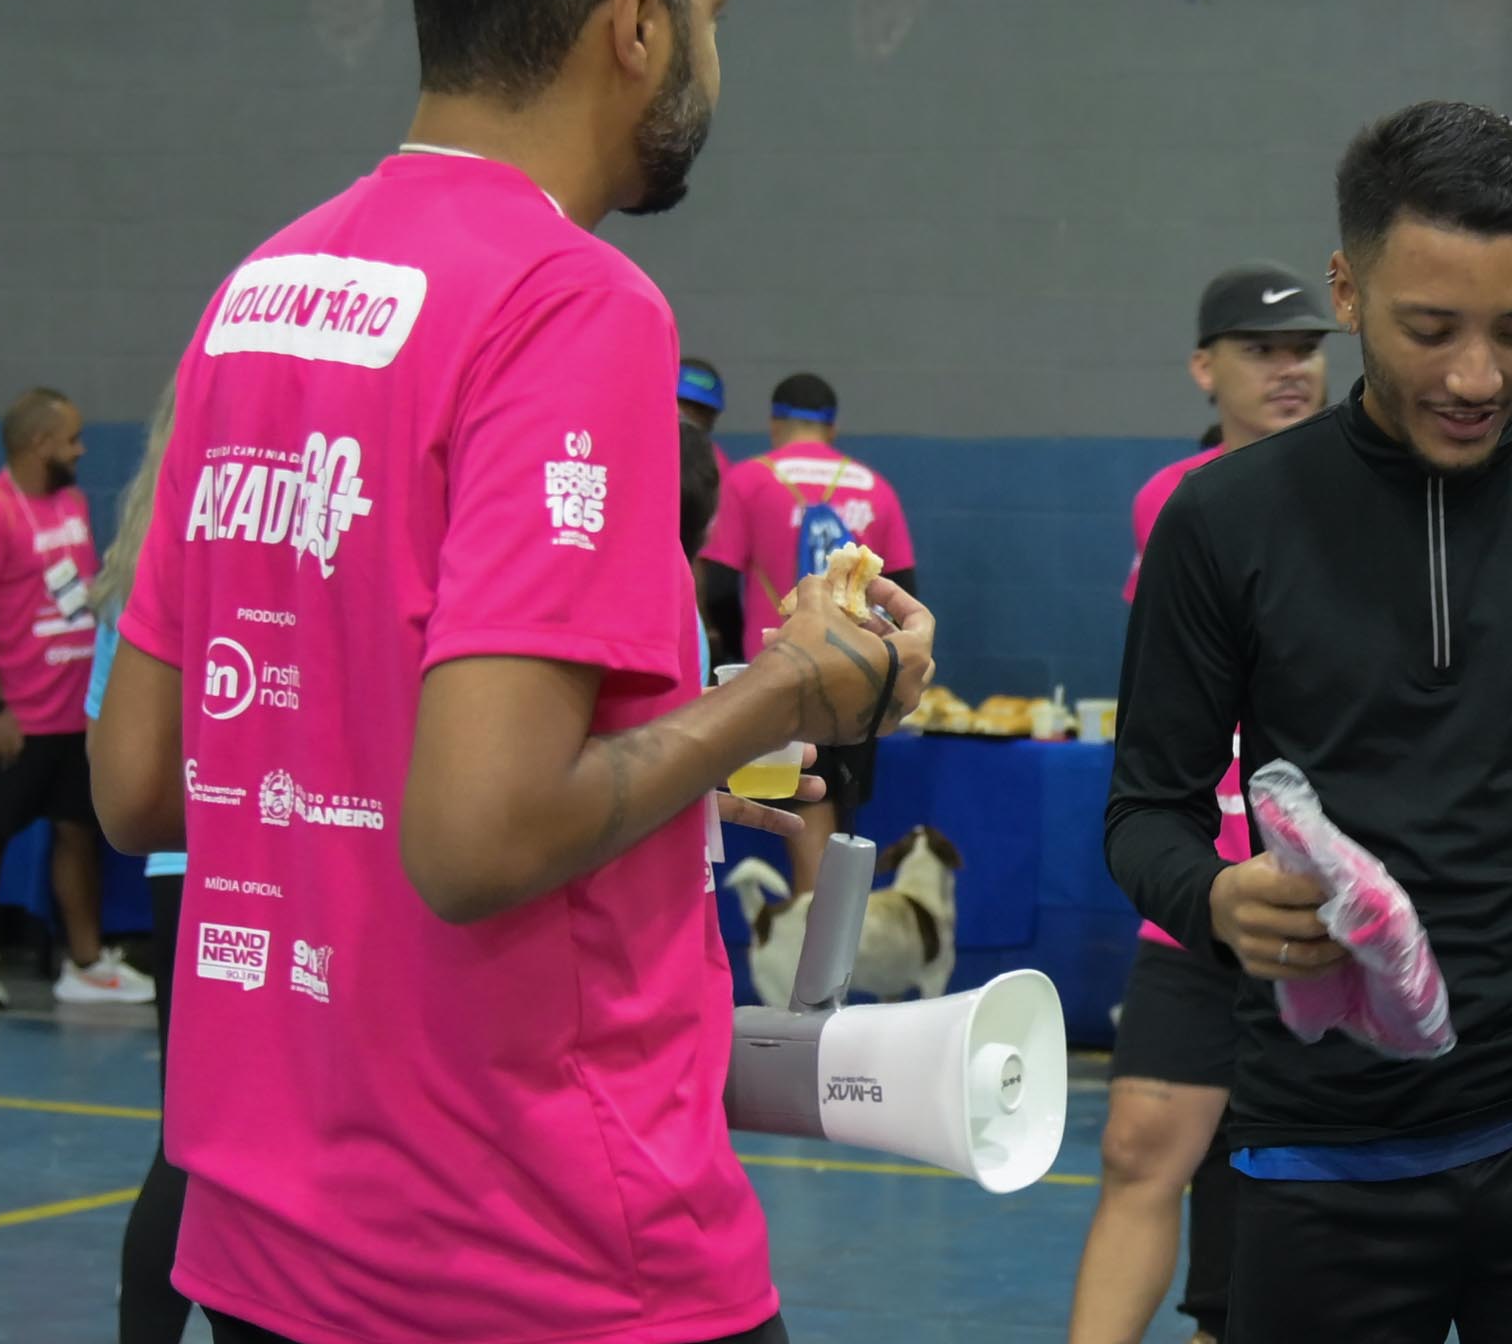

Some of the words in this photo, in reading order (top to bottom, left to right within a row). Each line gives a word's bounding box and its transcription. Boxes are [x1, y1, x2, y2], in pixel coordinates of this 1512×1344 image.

[186, 462, 300, 545] AZAD
[546, 495, 605, 533] 165
[237, 608, 297, 628] PRODUÇÃO
[304, 805, 385, 831] JANEIRO
[204, 875, 240, 893] MÍDIA
[242, 881, 284, 899] OFICIAL
[204, 927, 266, 950] BAND
[202, 945, 264, 968] NEWS
[826, 1082, 883, 1104] B-MAX
